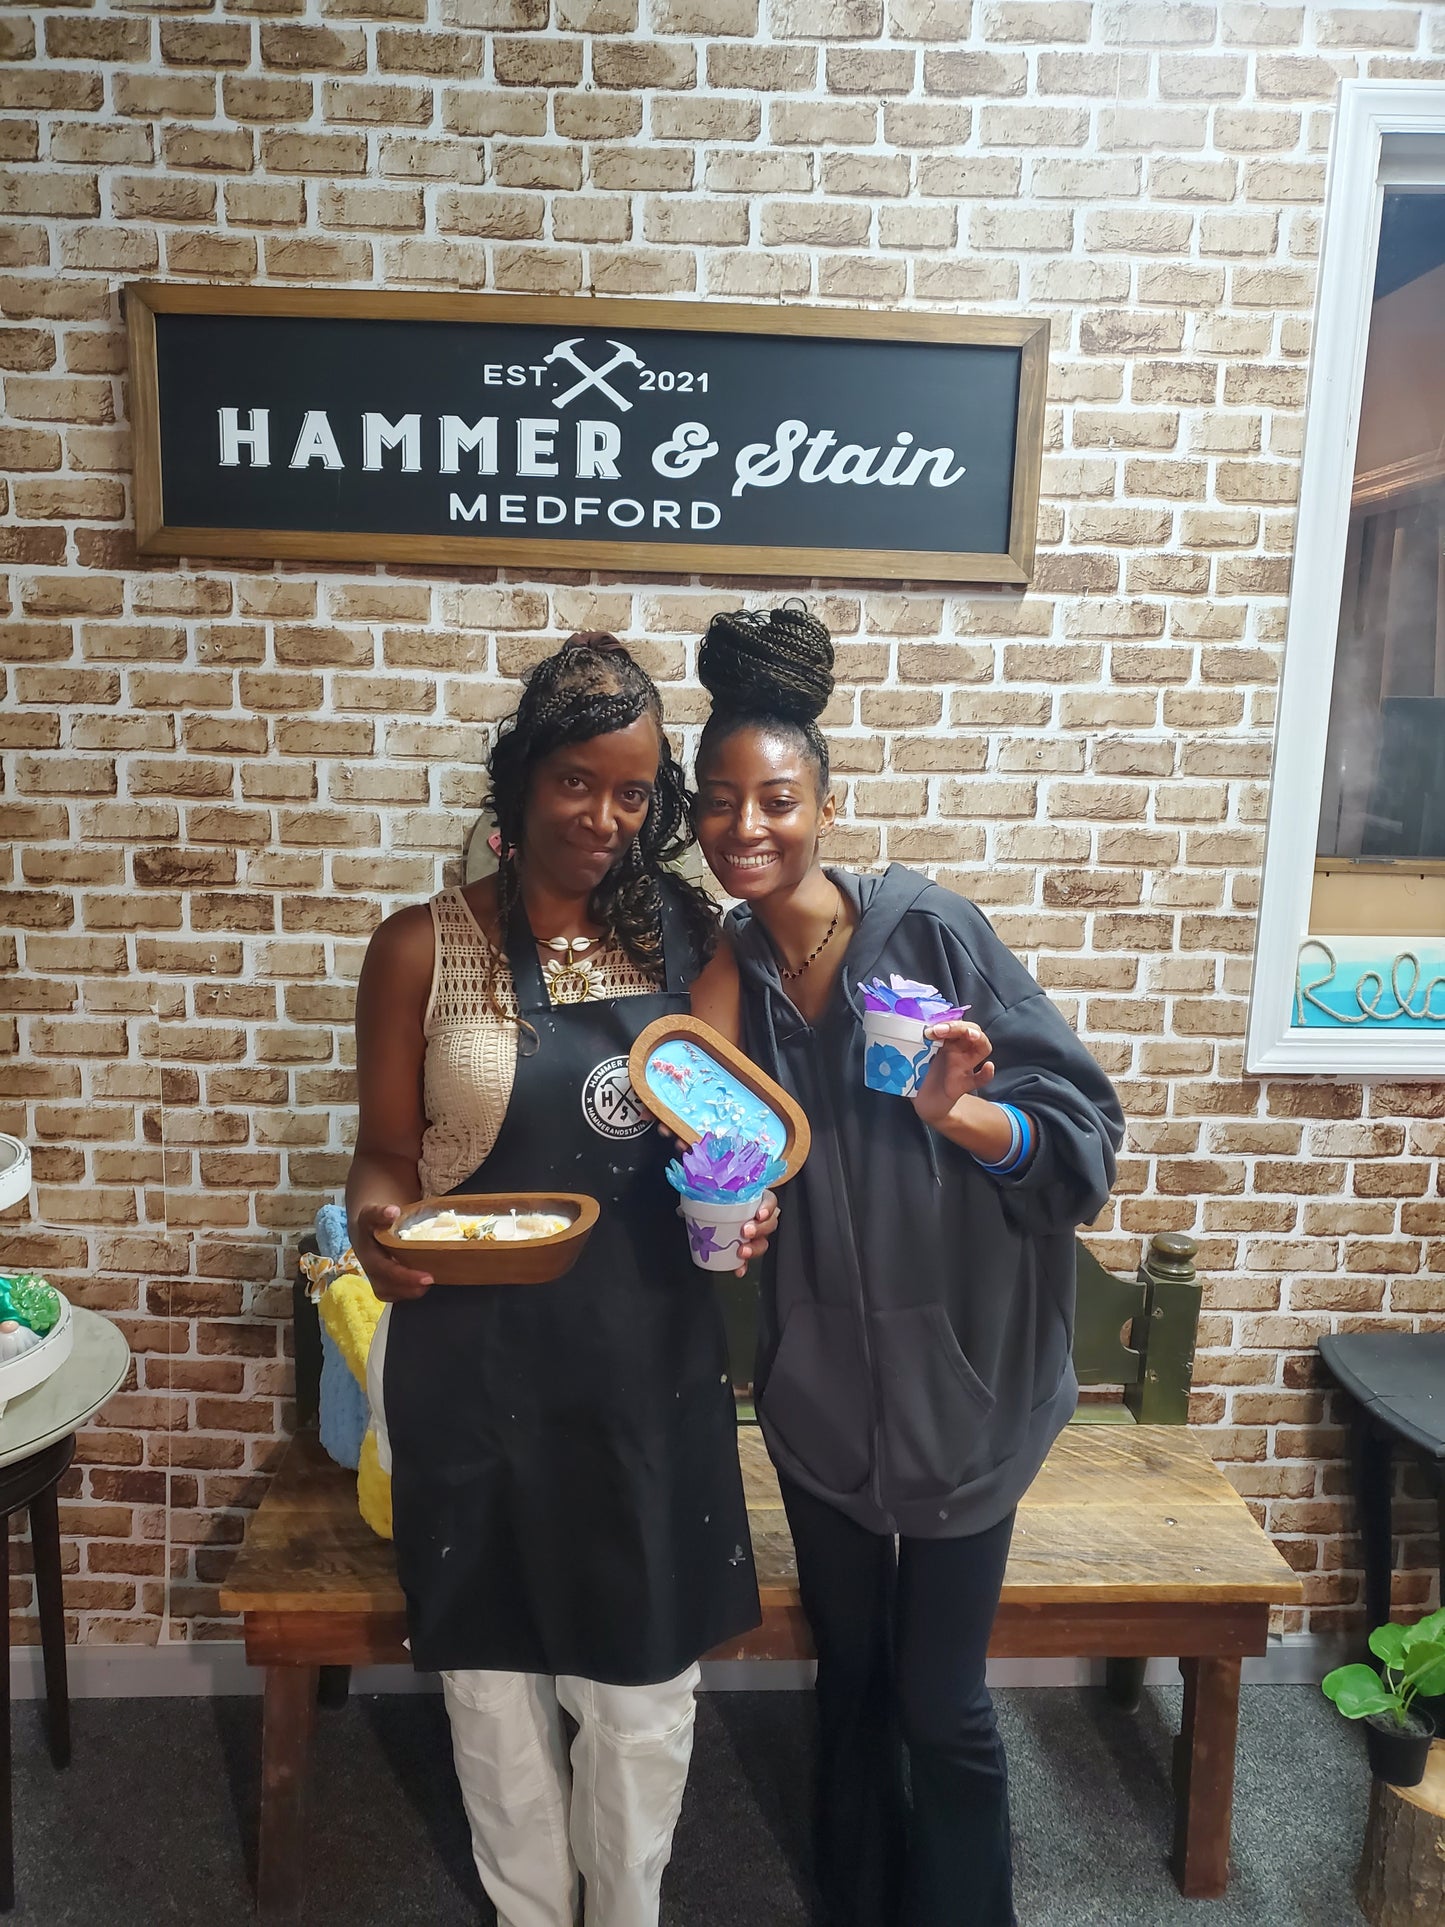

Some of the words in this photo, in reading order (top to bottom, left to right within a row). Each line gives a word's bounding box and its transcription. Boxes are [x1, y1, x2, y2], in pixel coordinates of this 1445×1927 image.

[484, 364, 559, 388] EST.
[638, 369, 710, 393] 2021
[216, 408, 623, 480] HAMMER
[652, 421, 720, 479] &
[732, 419, 967, 498] Stain
[449, 492, 722, 530] MEDFORD
[589, 1060, 623, 1088] HAMMER
